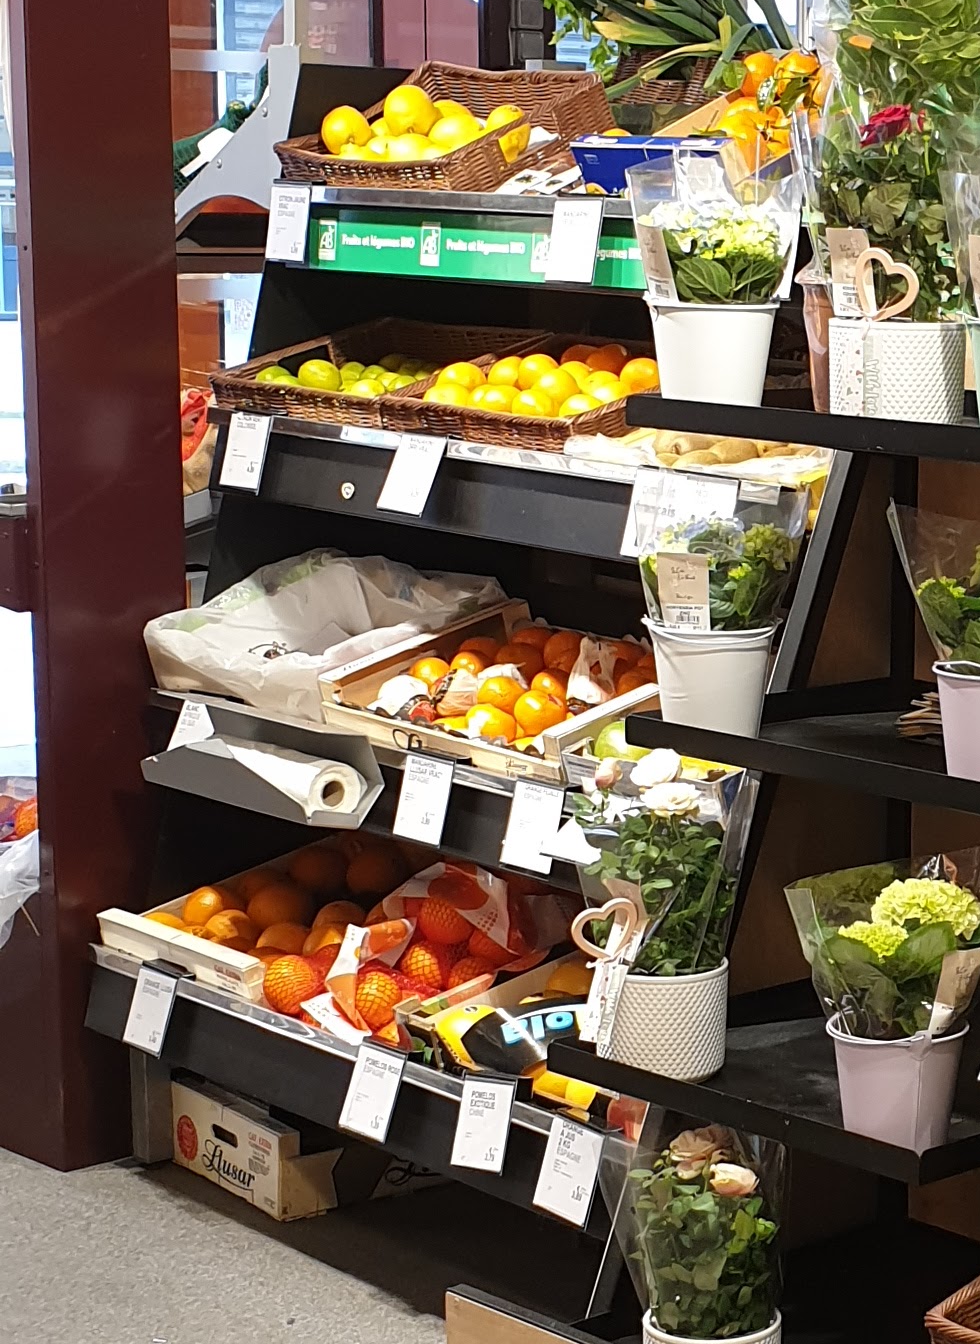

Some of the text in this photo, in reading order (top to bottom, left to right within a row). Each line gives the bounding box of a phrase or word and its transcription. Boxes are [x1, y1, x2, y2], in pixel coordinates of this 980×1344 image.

[342, 234, 361, 246] Fruits
[370, 235, 400, 249] légumes
[401, 236, 415, 249] BIO
[446, 238, 467, 252] Fruits
[476, 239, 509, 255] légumes
[510, 241, 525, 255] BIO
[366, 1056, 387, 1070] POMELOS
[471, 1089, 496, 1101] POMELOS
[470, 1098, 496, 1110] EXOTIQUE
